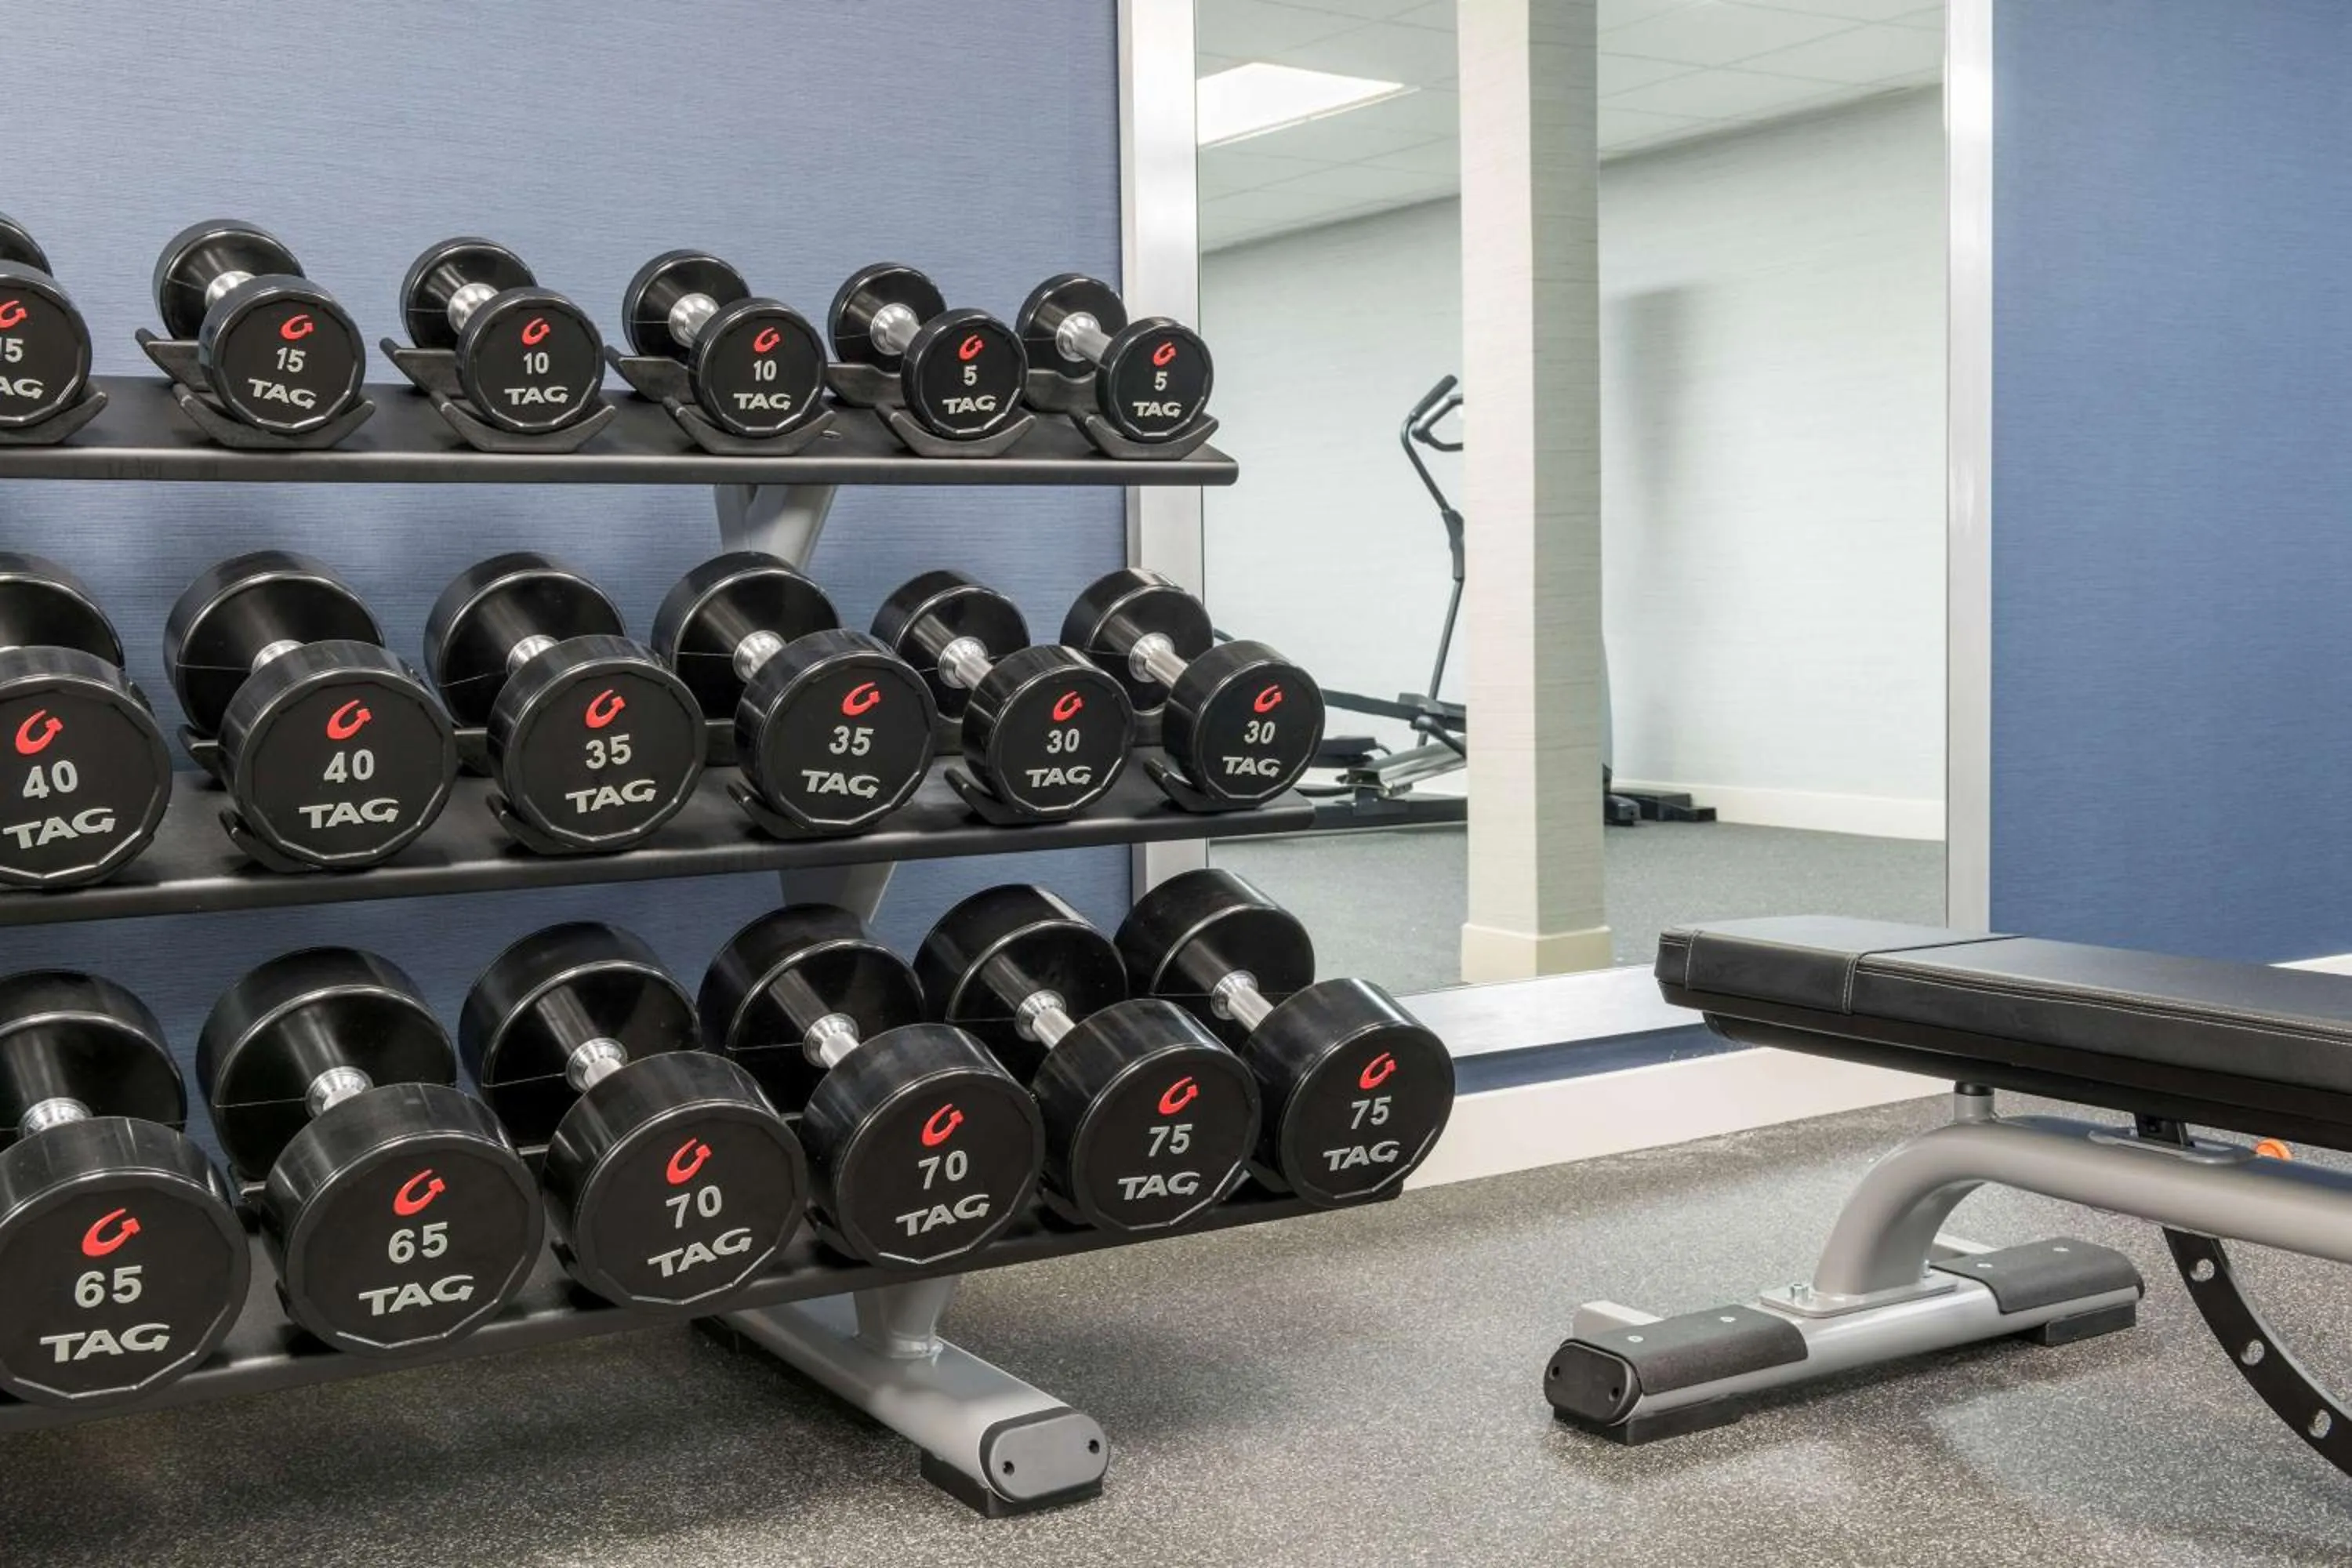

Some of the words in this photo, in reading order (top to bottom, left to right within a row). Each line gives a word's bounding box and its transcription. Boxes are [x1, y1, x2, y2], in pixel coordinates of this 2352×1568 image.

[277, 347, 306, 372] 15
[523, 352, 549, 374] 10
[753, 360, 777, 381] 10
[0, 376, 44, 400] AG
[964, 365, 977, 387] 5
[1154, 371, 1167, 391] 5
[248, 378, 317, 409] TAG
[504, 386, 568, 405] TAG
[733, 393, 791, 410] TAG
[942, 394, 996, 415] TAG
[1132, 401, 1181, 418] TAG
[829, 725, 874, 756] 35
[1047, 728, 1080, 753] 30
[1244, 720, 1276, 744] 30
[323, 749, 375, 783] 40
[586, 733, 631, 769] 35
[23, 760, 78, 799] 40
[1025, 765, 1092, 788] TAG
[1222, 757, 1280, 777] TAG
[565, 779, 656, 813] TAG
[801, 769, 880, 799] TAG
[2, 808, 116, 848] TAG
[299, 798, 399, 829] TAG
[1351, 1096, 1392, 1130] 75
[1149, 1123, 1192, 1156] 75
[918, 1150, 967, 1189] 70
[1323, 1141, 1399, 1171] TAG
[1117, 1171, 1200, 1200] TAG
[666, 1185, 722, 1229] 70
[895, 1194, 990, 1236] TAG
[388, 1221, 448, 1264] 65
[648, 1228, 752, 1277] TAG
[74, 1265, 142, 1308] 65
[358, 1274, 474, 1316] TAG
[40, 1323, 170, 1363] TAG
